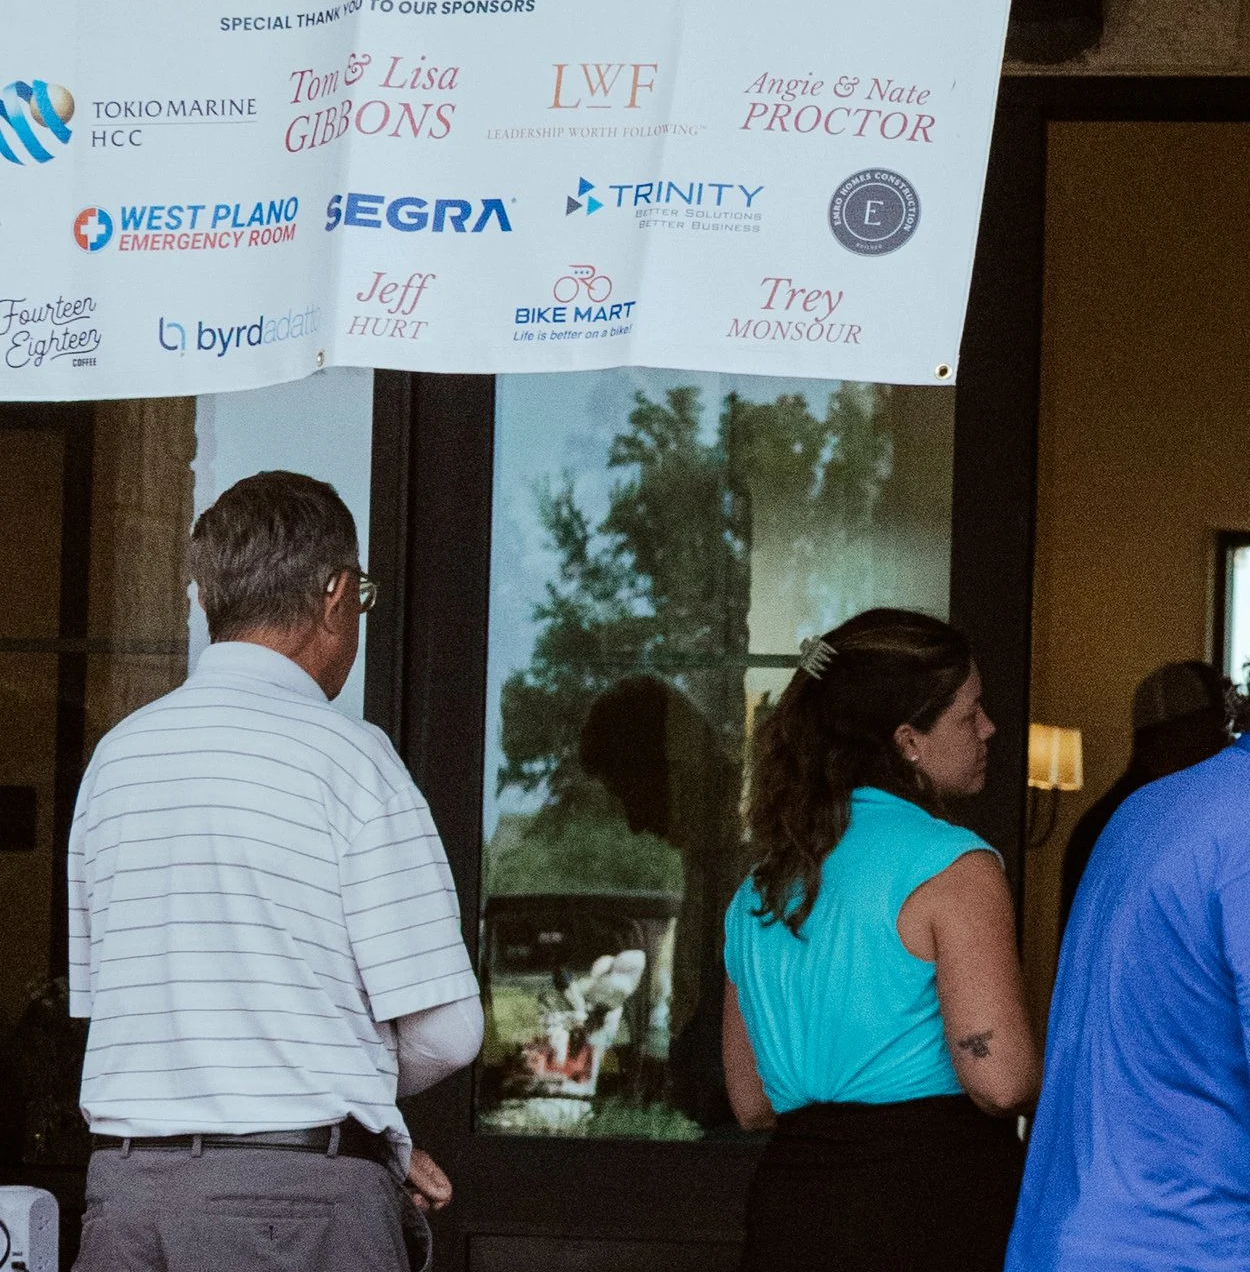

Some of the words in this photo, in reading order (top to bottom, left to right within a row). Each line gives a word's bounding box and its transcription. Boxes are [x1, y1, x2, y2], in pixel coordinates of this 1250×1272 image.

[220, 16, 292, 31] SPECIAL
[297, 6, 342, 28] THANK
[399, 0, 438, 15] OUR
[289, 69, 339, 104] Tom
[344, 53, 372, 86] &
[378, 55, 460, 90] Lisa
[547, 63, 658, 109] LWF
[744, 71, 824, 102] Angie
[833, 75, 860, 98] &
[864, 78, 931, 106] Nate
[93, 100, 162, 119] TOKIO
[166, 98, 257, 117] MARINE
[739, 102, 936, 143] PROCTOR
[91, 130, 142, 147] HCC
[285, 99, 457, 153] GIBBONS
[487, 127, 564, 140] LEADERSHIP
[568, 127, 617, 139] WORTH
[609, 181, 764, 208] TRINITY
[874, 172, 916, 232] CONSTRUCTION
[120, 205, 206, 231] WEST
[211, 196, 298, 229] PLANO
[864, 200, 884, 226] E
[118, 231, 245, 251] EMERGENCY
[248, 223, 297, 247] ROOM
[356, 271, 436, 316] Jeff
[759, 277, 844, 321] Trey
[0, 295, 97, 334] Fourteen
[346, 316, 429, 340] HURT
[515, 307, 567, 324] BIKE
[573, 301, 636, 323] MART
[513, 330, 534, 341] Life
[537, 331, 547, 341] is
[550, 330, 582, 340] better
[585, 331, 599, 339] on
[726, 318, 862, 344] MONSOUR
[6, 328, 101, 369] Eighteen
[72, 358, 97, 368] COFFEE
